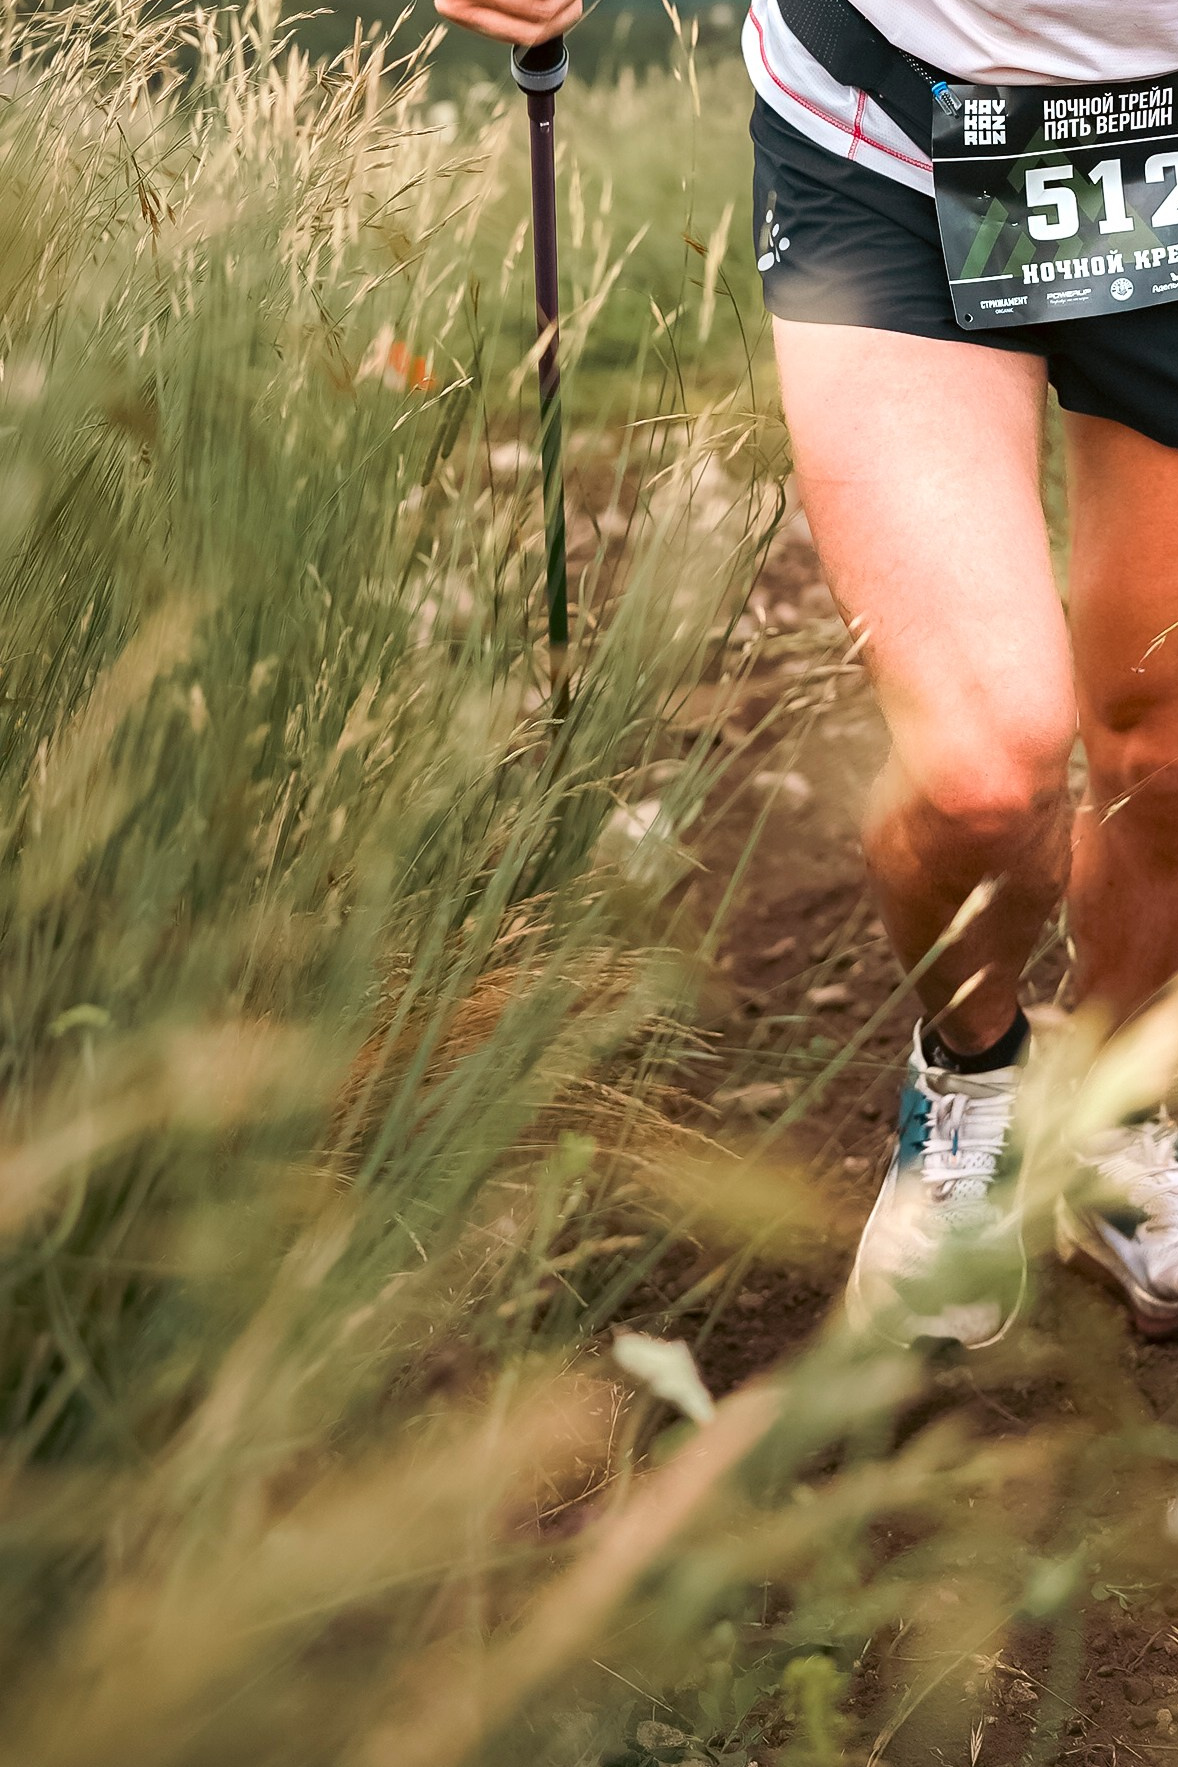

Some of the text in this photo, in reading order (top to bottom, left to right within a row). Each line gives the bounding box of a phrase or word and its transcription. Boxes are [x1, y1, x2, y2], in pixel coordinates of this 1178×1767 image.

[964, 99, 1007, 115] KAV
[1043, 86, 1173, 120] НОЧНОЙ ТРЕЙЛ
[963, 116, 1006, 131] KAZ
[1044, 107, 1173, 141] ПЯТЬ ВЕРШИН
[964, 131, 1007, 146] RUN
[1022, 249, 1125, 285] НОЧНОЙ
